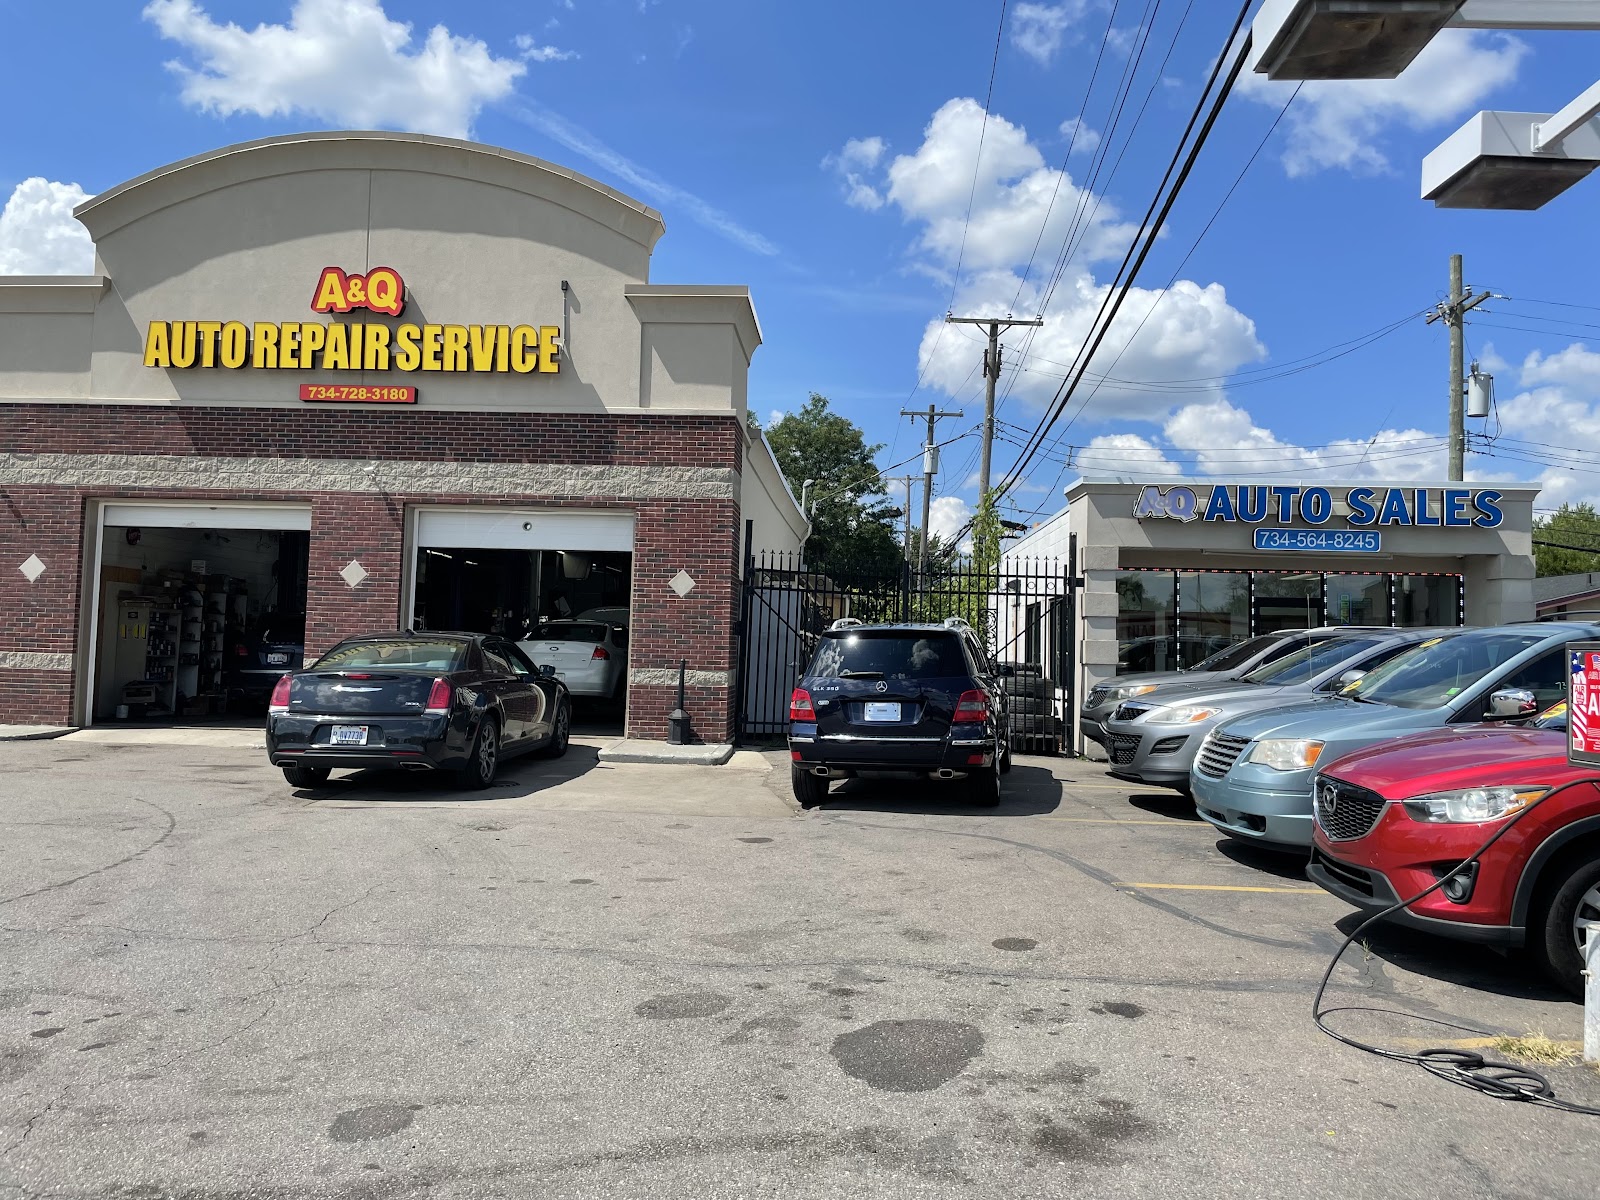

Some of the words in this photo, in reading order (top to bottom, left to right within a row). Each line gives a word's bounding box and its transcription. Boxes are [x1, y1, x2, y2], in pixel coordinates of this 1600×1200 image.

[313, 269, 403, 313] A&Q
[143, 320, 250, 369] AUTO
[252, 321, 393, 371] REPAIR
[395, 323, 561, 373] SERVICE
[307, 385, 409, 402] 734-728-3180
[1133, 485, 1199, 522] A&Q
[1202, 485, 1333, 524] AUTO
[1346, 487, 1505, 528] SALES
[1258, 530, 1376, 550] 734-564-8245
[1574, 685, 1585, 693] AIR
[1588, 692, 1600, 717] A
